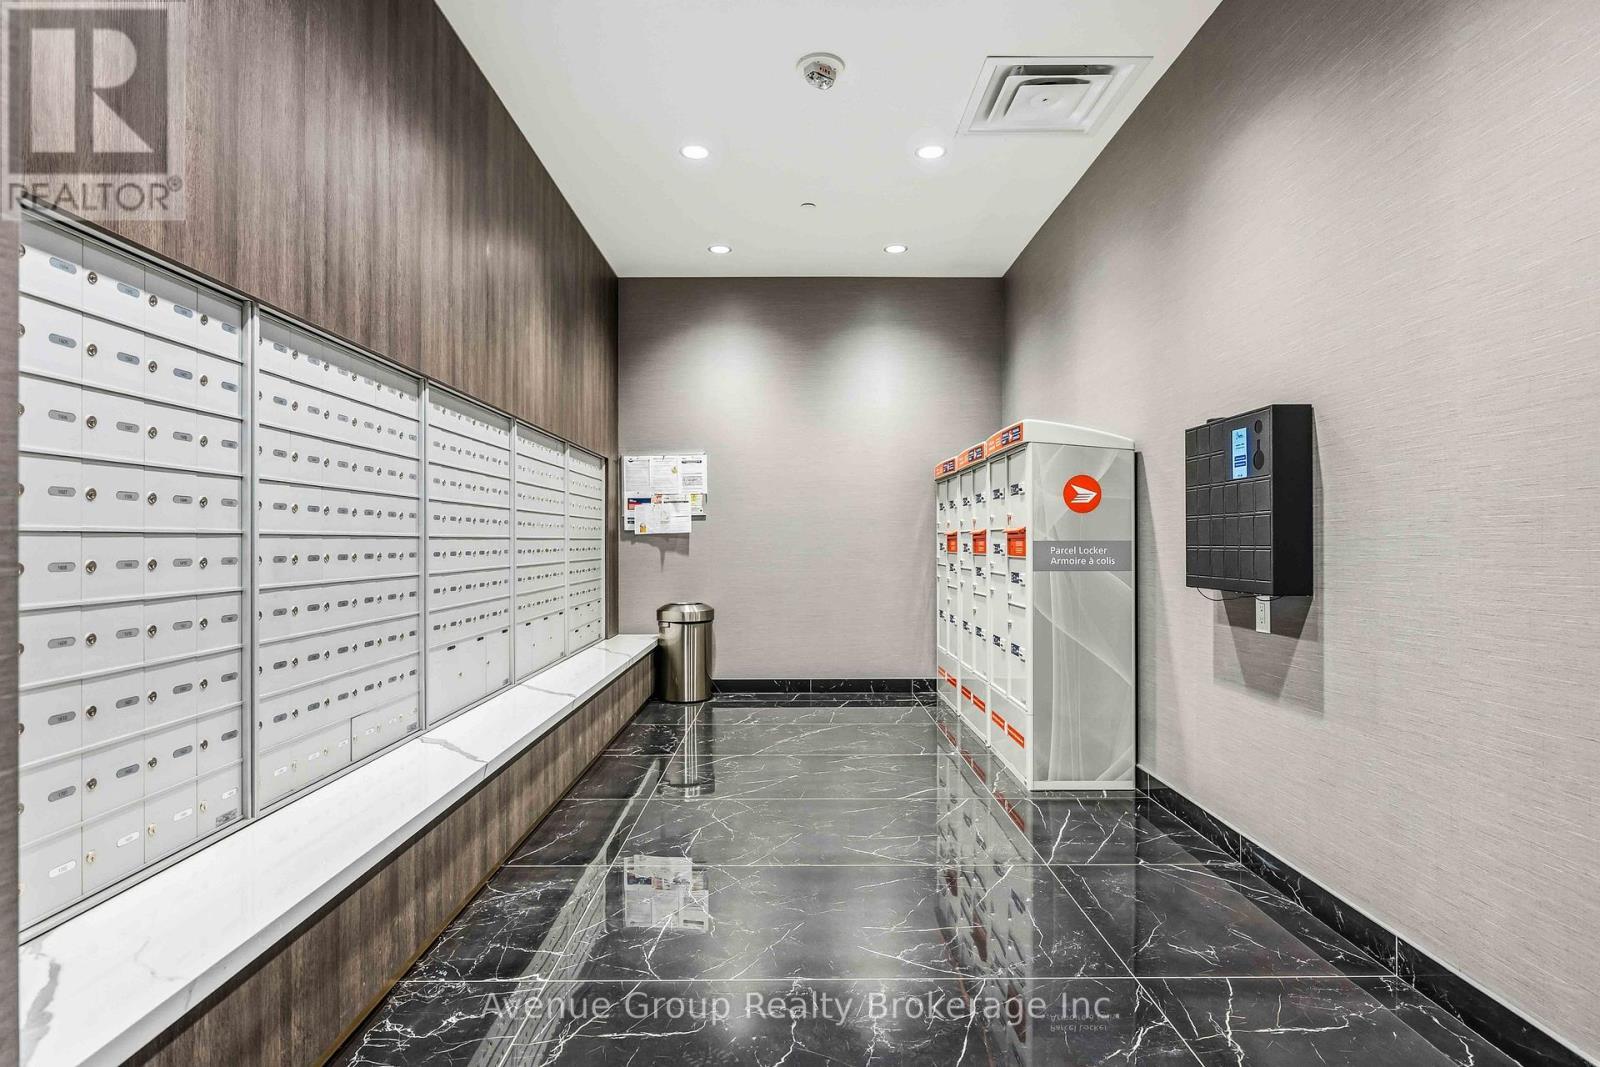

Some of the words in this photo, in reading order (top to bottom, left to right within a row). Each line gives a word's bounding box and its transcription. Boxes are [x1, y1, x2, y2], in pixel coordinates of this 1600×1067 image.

[1050, 546, 1076, 555] Parcel
[1079, 546, 1108, 555] Locker
[1050, 557, 1087, 565] Armoire
[1088, 556, 1094, 565] à
[1096, 556, 1116, 565] colis
